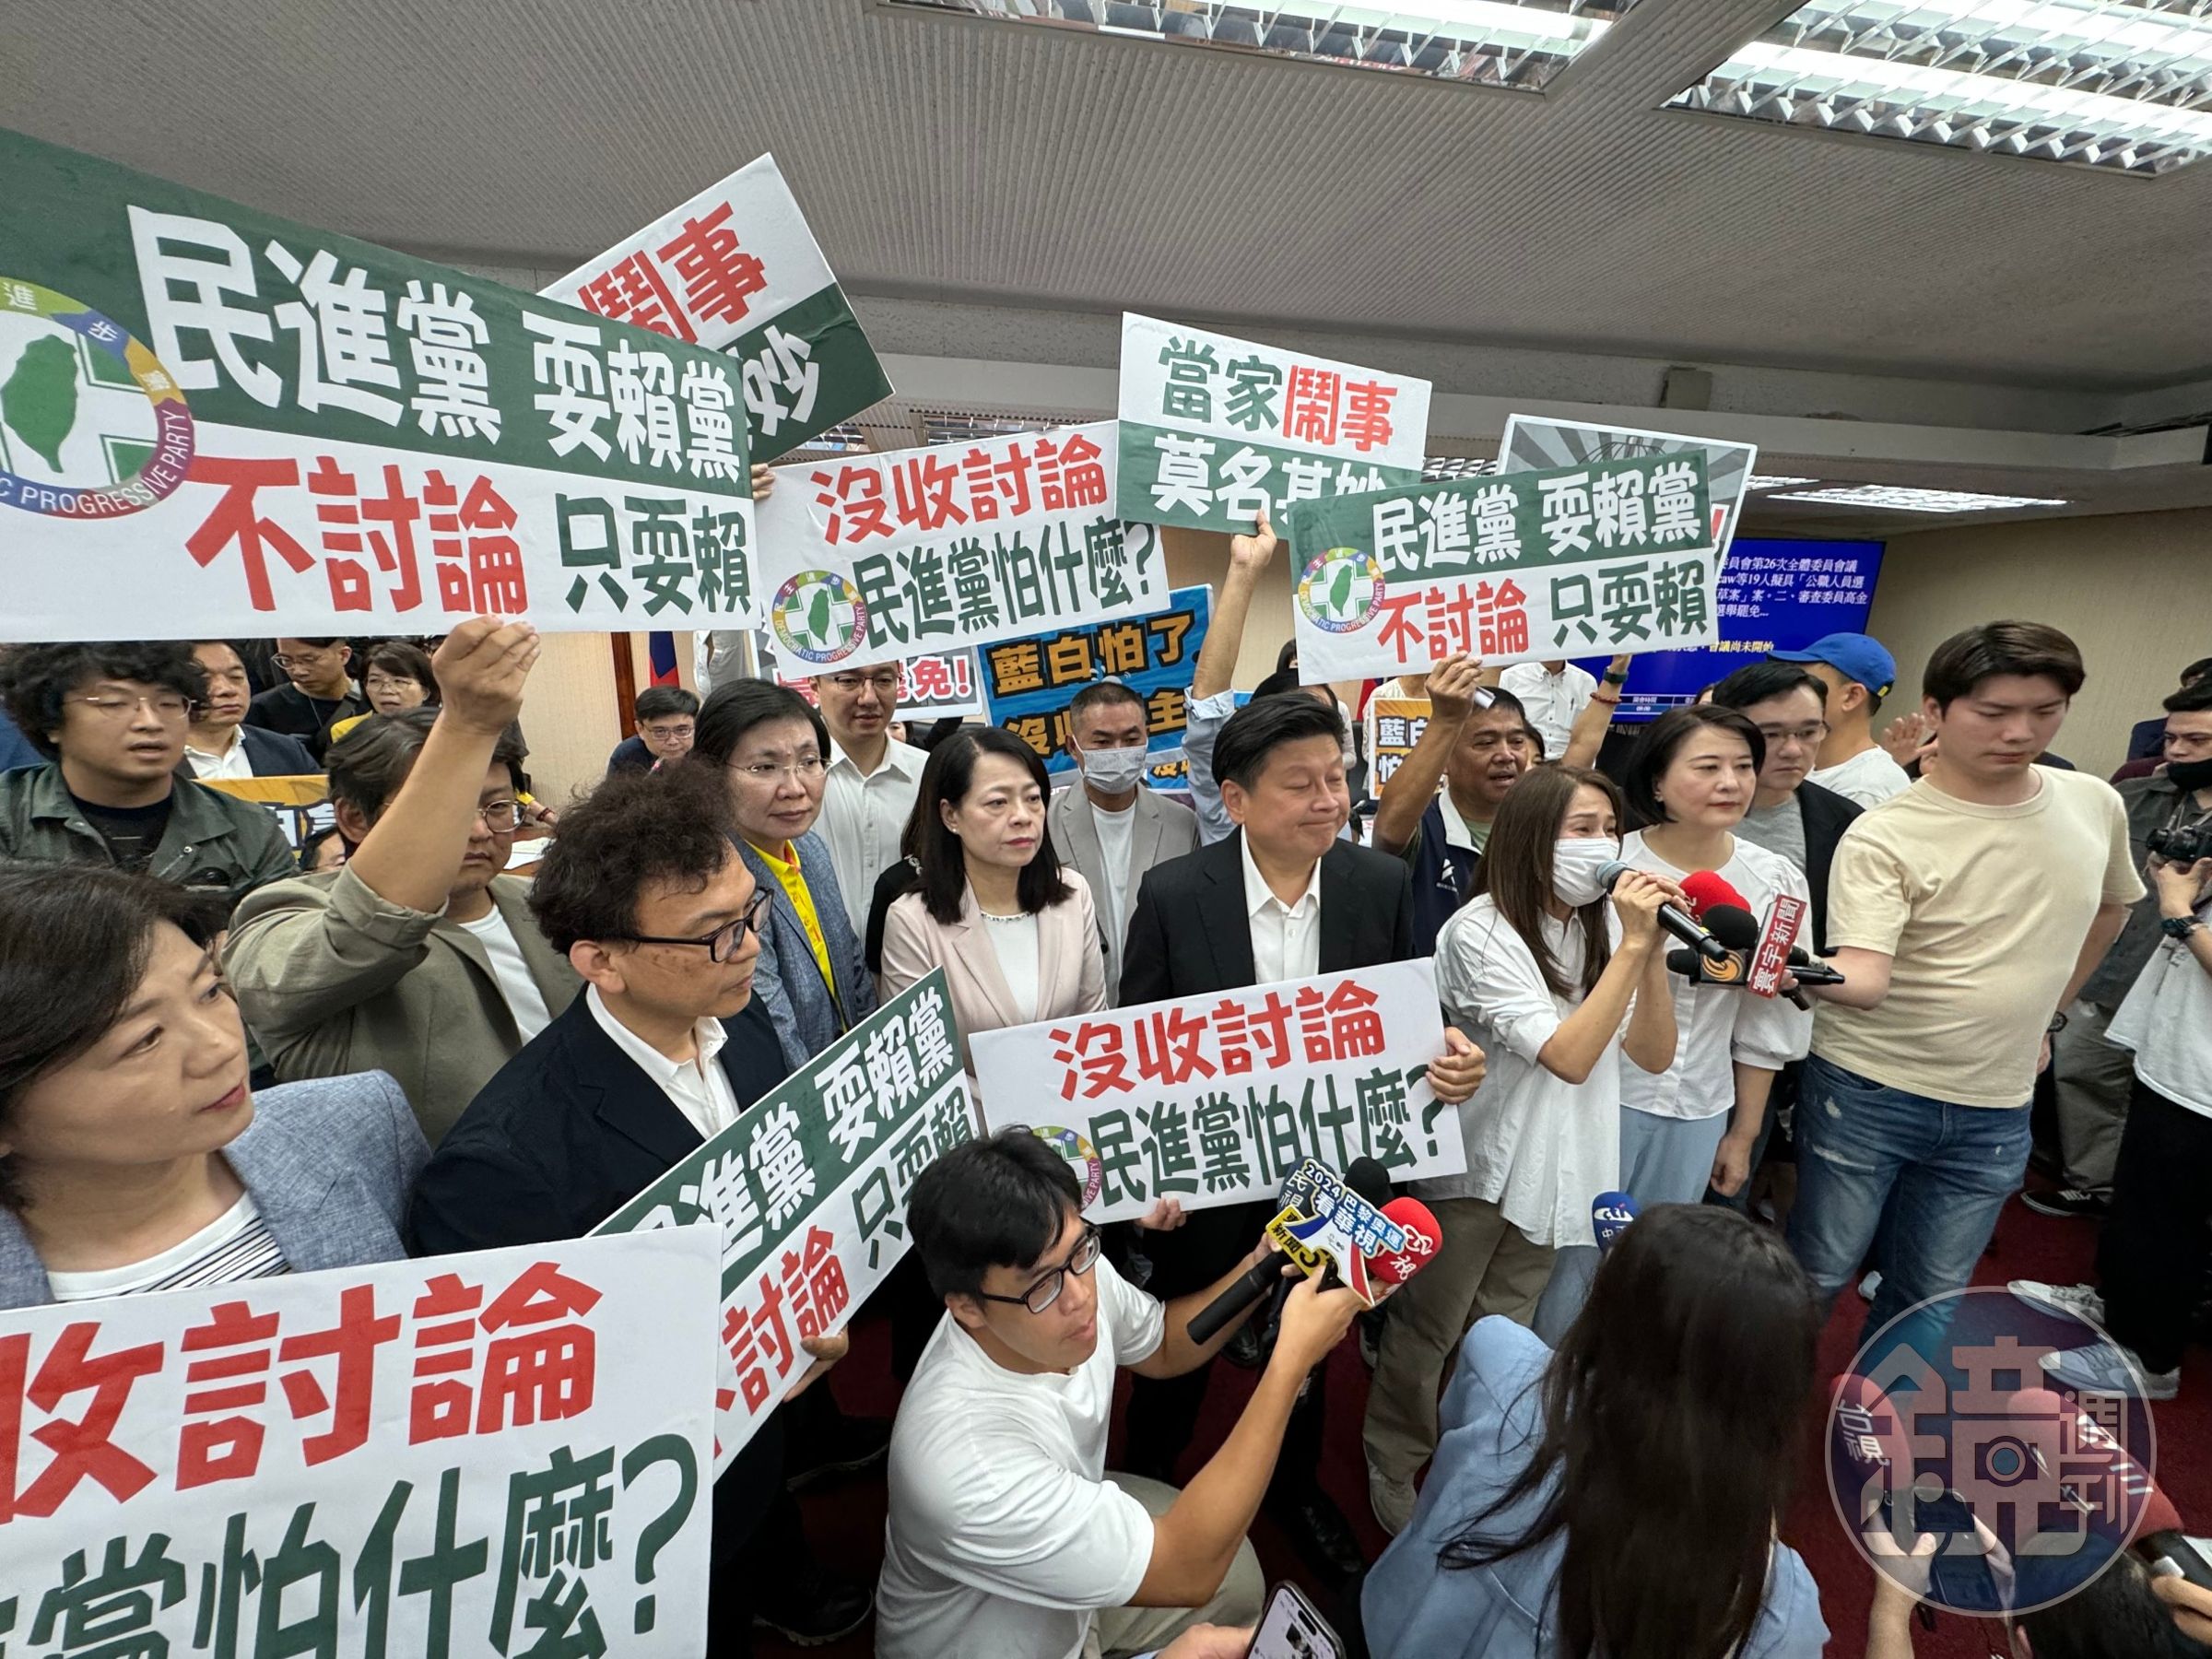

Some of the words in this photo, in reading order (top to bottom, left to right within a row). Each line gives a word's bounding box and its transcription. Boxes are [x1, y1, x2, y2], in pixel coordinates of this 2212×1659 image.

[578, 201, 768, 344] 鬧事
[127, 205, 501, 444] 民進黨
[523, 311, 740, 482] 耍賴黨
[734, 325, 819, 450] 妙
[1158, 335, 1398, 452] 當家鬧事
[20, 464, 177, 513] PROGRESSIVE
[162, 409, 188, 469] PARTY
[811, 433, 1108, 546] 沒收討論
[1372, 482, 1523, 572] 民進黨
[1537, 461, 1702, 557] 耍賴黨
[184, 454, 528, 615] 不討論
[556, 492, 751, 615] 只耍賴
[852, 515, 1156, 650] 民進黨怕什麼?
[991, 613, 1193, 694] 藍白怕了
[1378, 577, 1529, 664] 不討論
[1550, 559, 1708, 648] 只耍賴
[815, 986, 954, 1163] 耍賴黨
[1049, 980, 1384, 1101] 沒收討論
[1088, 1064, 1444, 1206] 民進黨怕什麼?
[1305, 1163, 1342, 1198] 2024
[1315, 1191, 1376, 1254] 看華視
[714, 1225, 849, 1459] 討論
[0, 1433, 699, 1659] 黨怕什麼?
